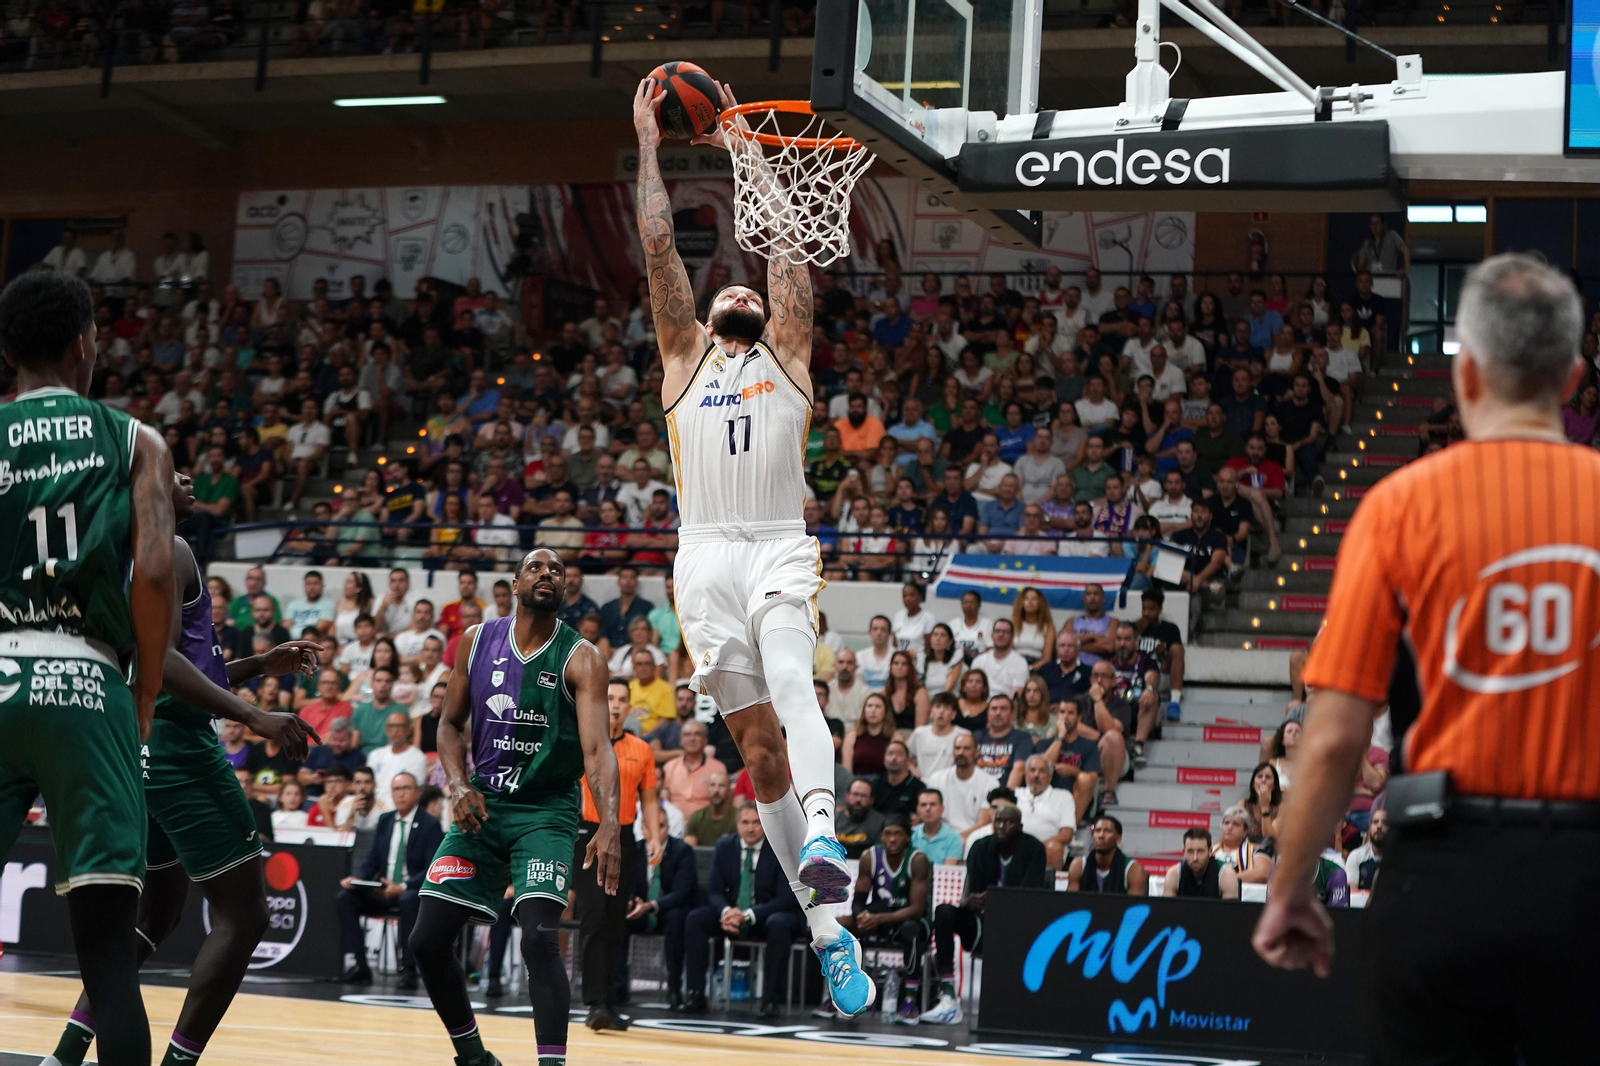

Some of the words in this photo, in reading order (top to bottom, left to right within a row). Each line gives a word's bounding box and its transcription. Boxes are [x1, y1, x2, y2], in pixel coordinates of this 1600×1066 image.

[623, 154, 690, 171] Gda
[1015, 138, 1230, 187] endesa
[8, 415, 93, 447] CARTER
[28, 502, 78, 564] 11
[1485, 582, 1573, 656] 60
[33, 659, 105, 681] COSTA
[31, 675, 68, 690] DEL
[72, 675, 106, 697] SOL
[29, 690, 104, 713] MÁLAGA
[513, 709, 548, 724] Unicaj
[527, 869, 554, 883] laga
[531, 860, 554, 872] má
[1169, 1009, 1251, 1032] Movistar
